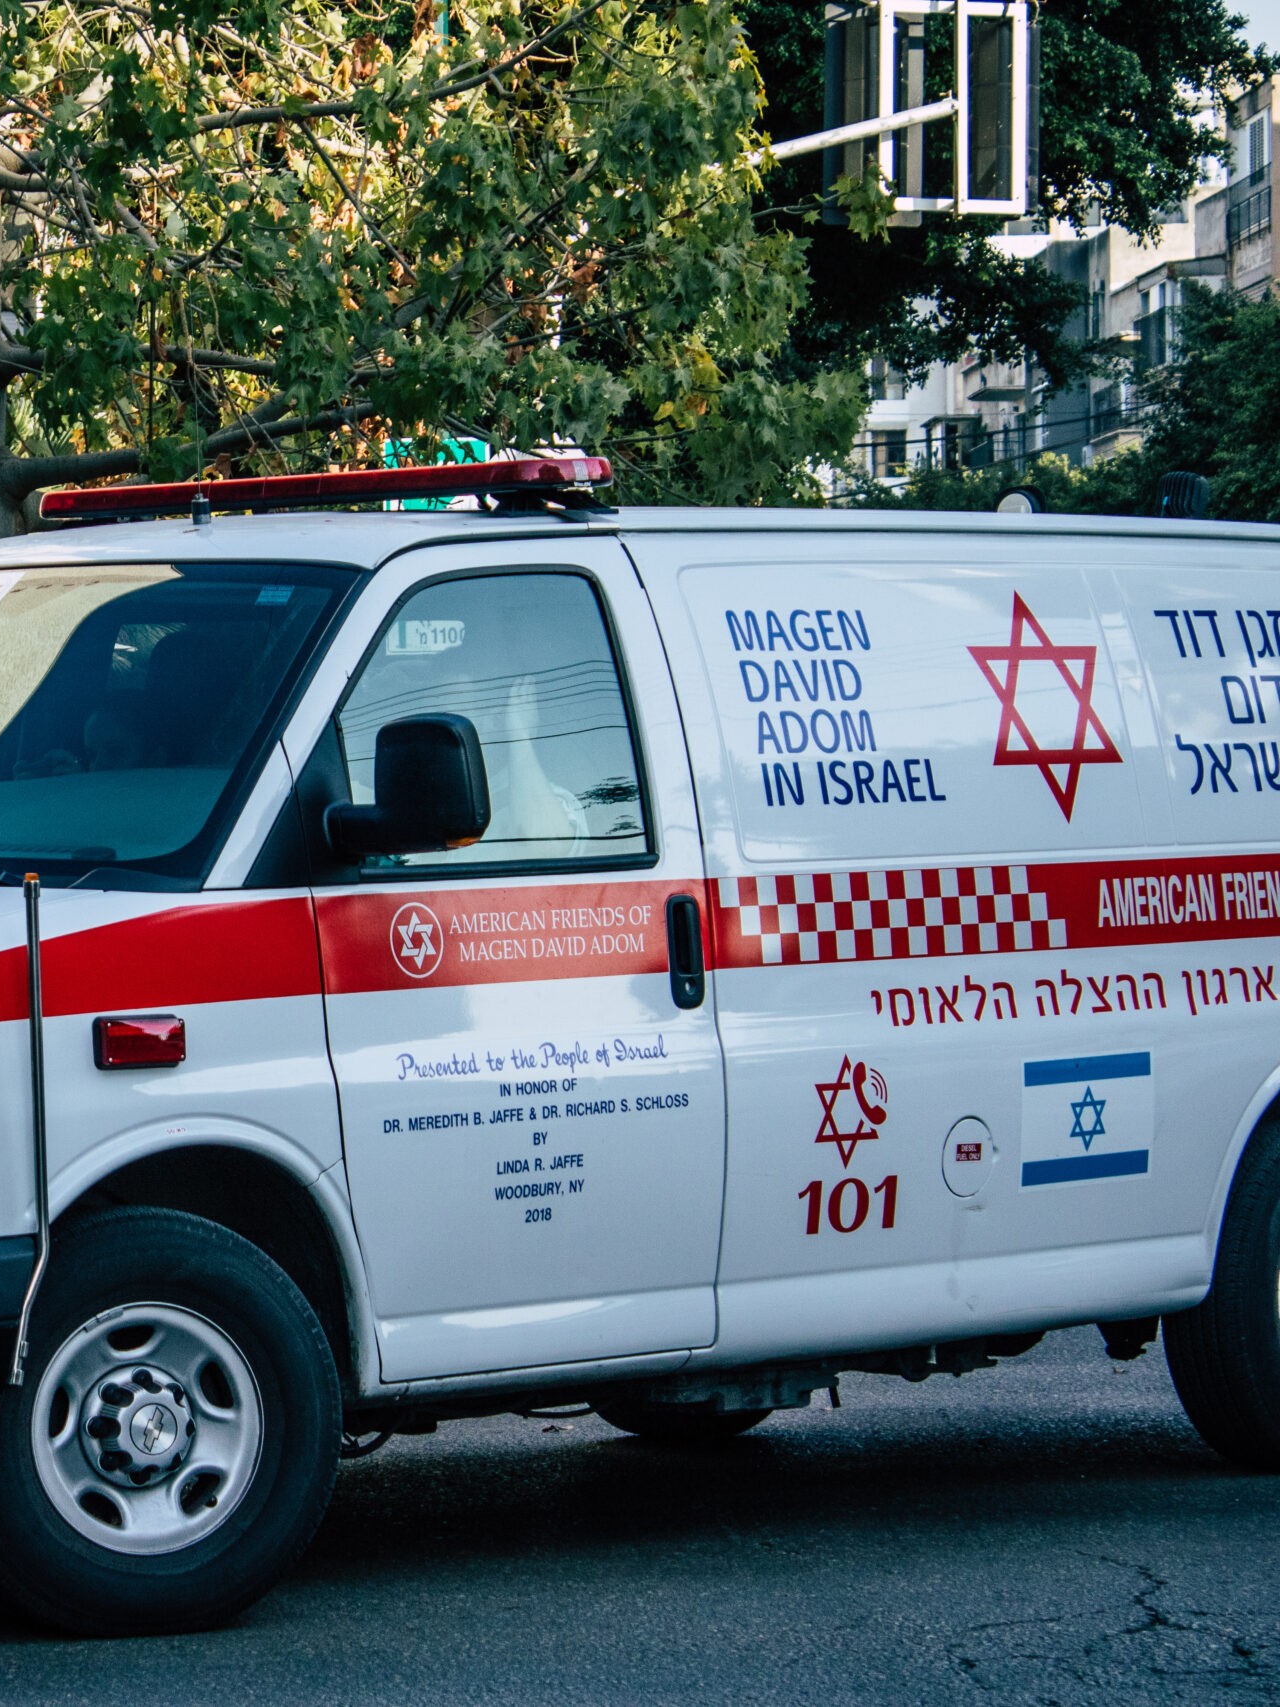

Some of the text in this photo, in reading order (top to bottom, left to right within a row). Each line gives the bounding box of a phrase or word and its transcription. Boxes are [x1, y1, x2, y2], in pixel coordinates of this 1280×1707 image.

[725, 609, 871, 651] MAGEN
[1153, 610, 1226, 658] דוד
[738, 659, 862, 702] DAVID
[758, 708, 877, 754] ADOM
[761, 758, 947, 806] IN ISRAEL
[449, 905, 651, 934] AMERICAN FRIENDS OF
[1098, 873, 1217, 928] AMERICAN
[459, 933, 645, 962] MAGEN DAVID ADOM
[870, 965, 1278, 1027] ארגון ההצלה הלאומי
[396, 1032, 669, 1080] Presented to the People of Israel
[500, 1078, 578, 1097] IN HONOR OF
[383, 1093, 689, 1133] DR. MEREDITH B. JAFFE & DR. RICHARD S. SCHLOSS
[533, 1131, 548, 1146] BY
[496, 1154, 584, 1175] LINDA R. JAFFE
[495, 1179, 584, 1201] WOODBURY, NY
[798, 1174, 898, 1235] 101
[525, 1207, 552, 1223] 2018
